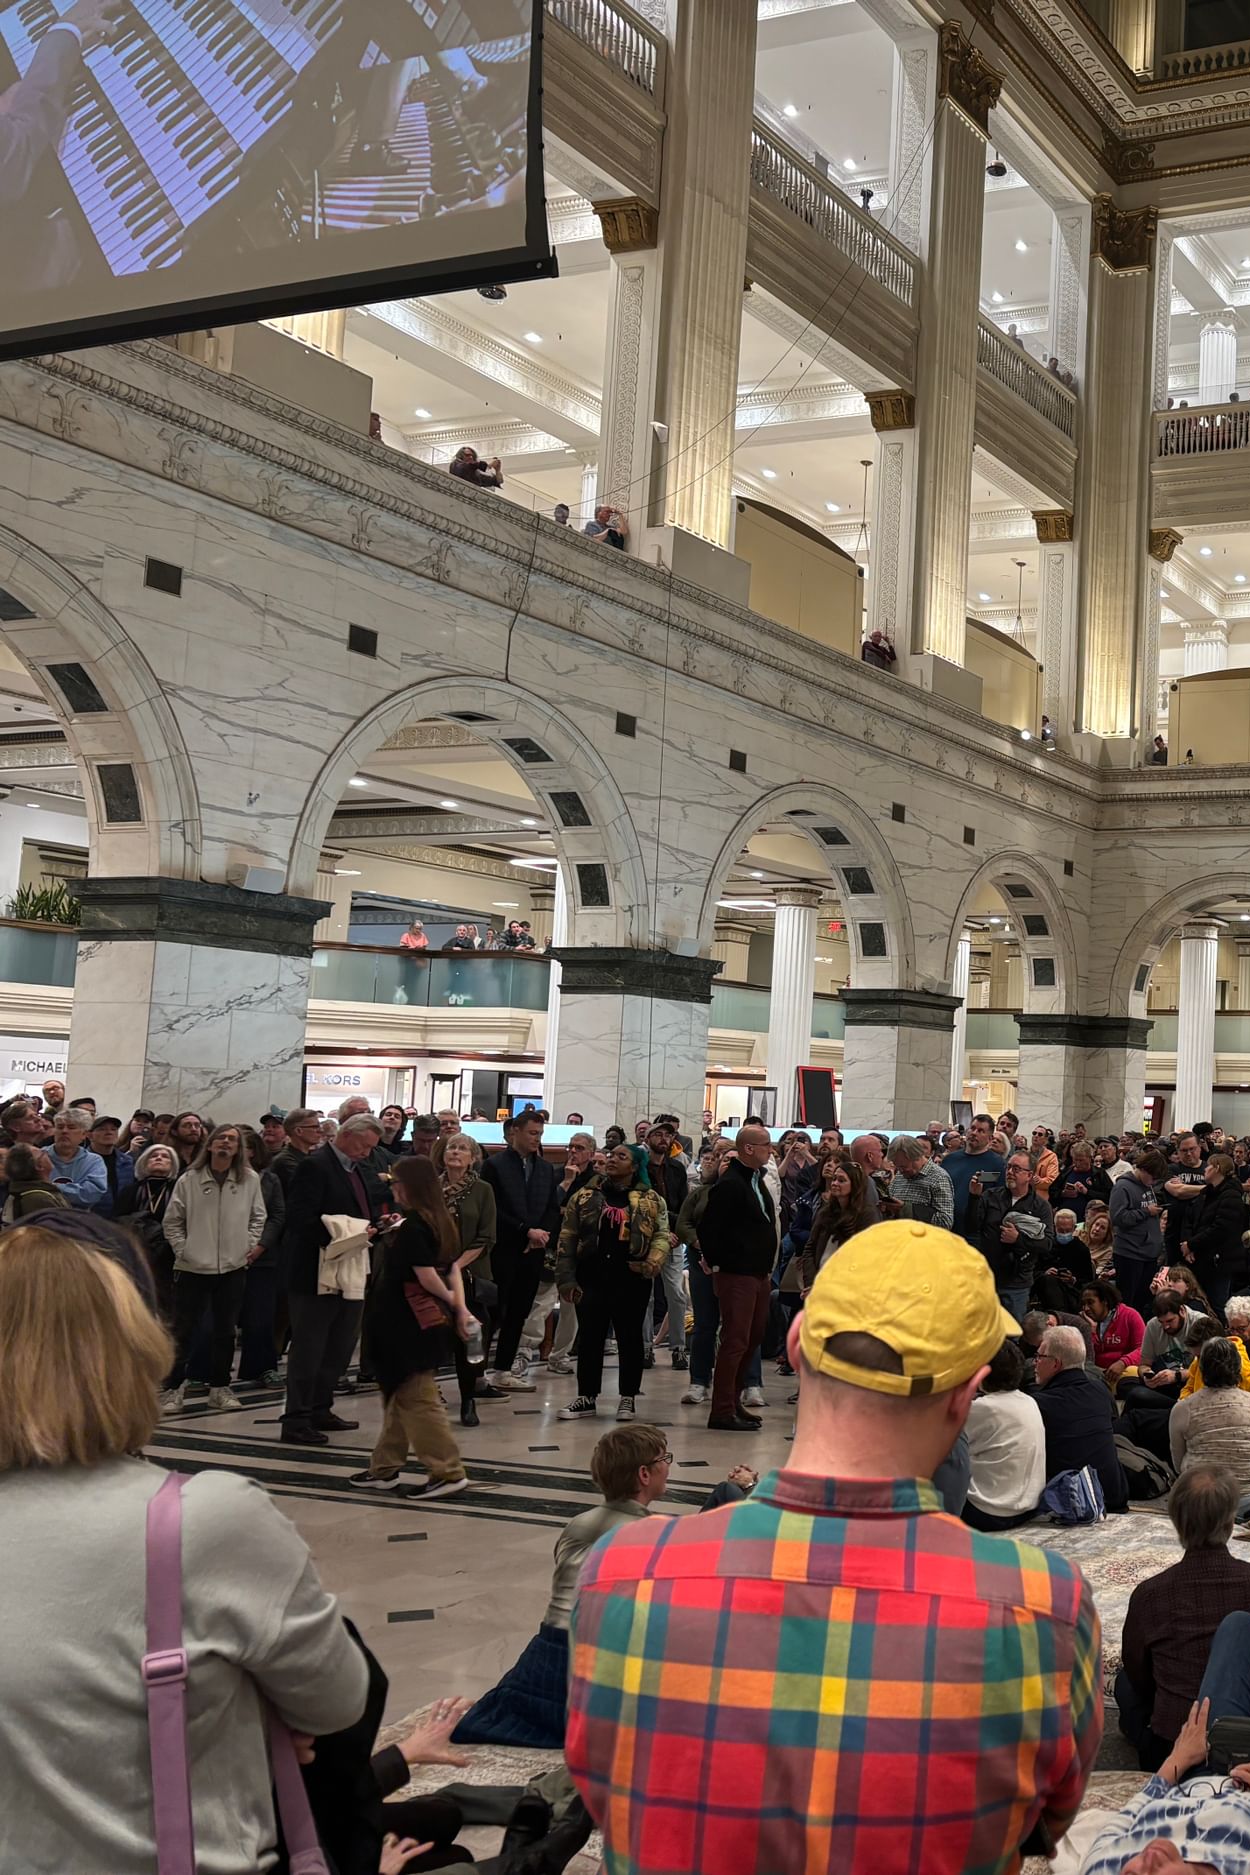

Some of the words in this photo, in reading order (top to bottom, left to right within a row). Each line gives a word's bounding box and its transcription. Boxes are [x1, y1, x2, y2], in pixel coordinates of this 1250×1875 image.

[11, 1060, 68, 1073] MICHAEL
[323, 1074, 361, 1086] KORS
[1192, 1174, 1205, 1182] YOR
